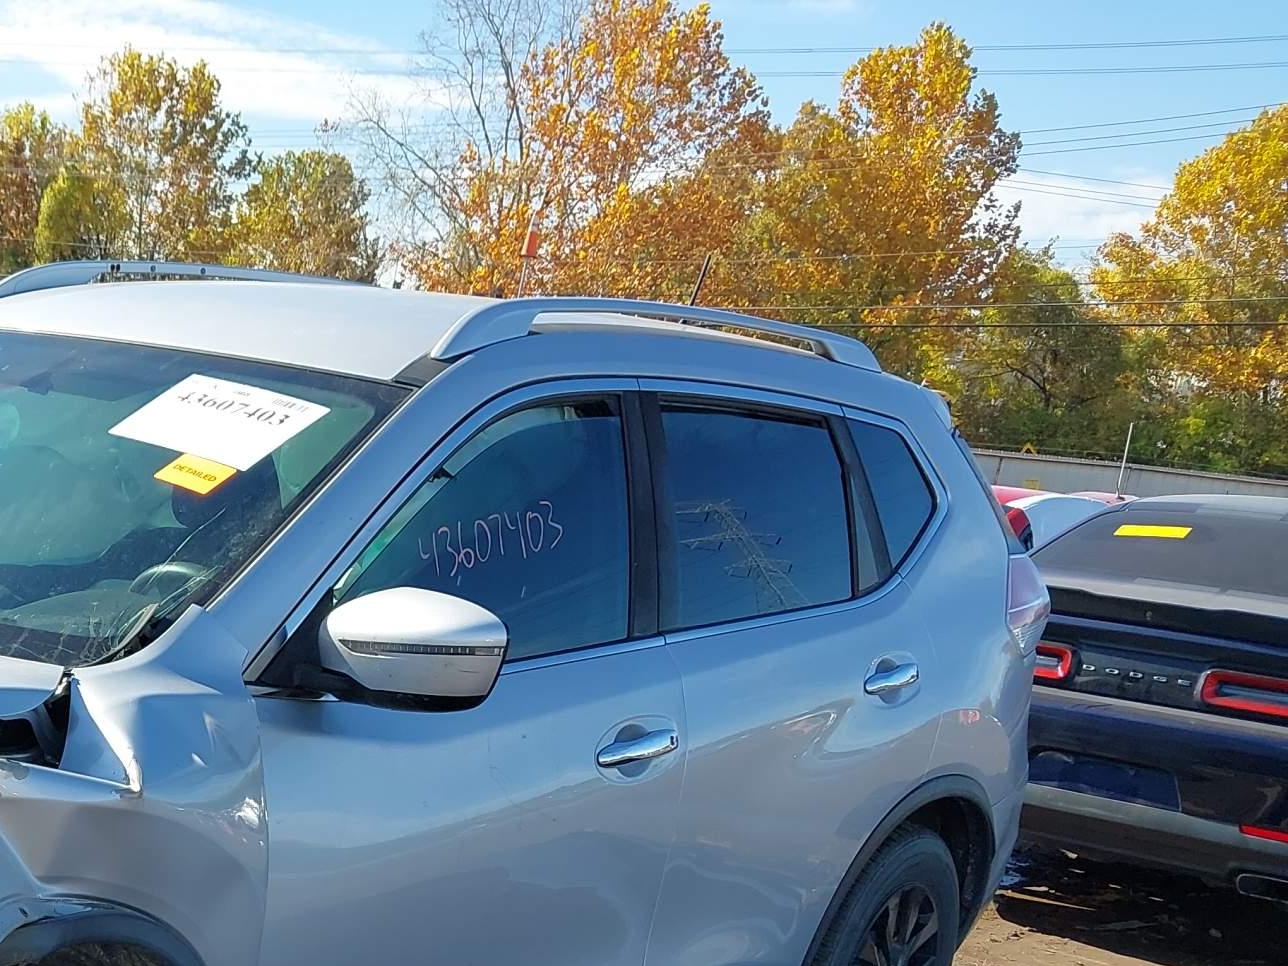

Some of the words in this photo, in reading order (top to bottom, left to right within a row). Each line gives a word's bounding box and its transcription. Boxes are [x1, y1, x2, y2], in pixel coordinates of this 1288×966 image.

[177, 391, 291, 426] 43607403
[172, 462, 217, 483] DETAILED
[418, 500, 563, 577] 43607403
[1081, 663, 1193, 688] DODGE
